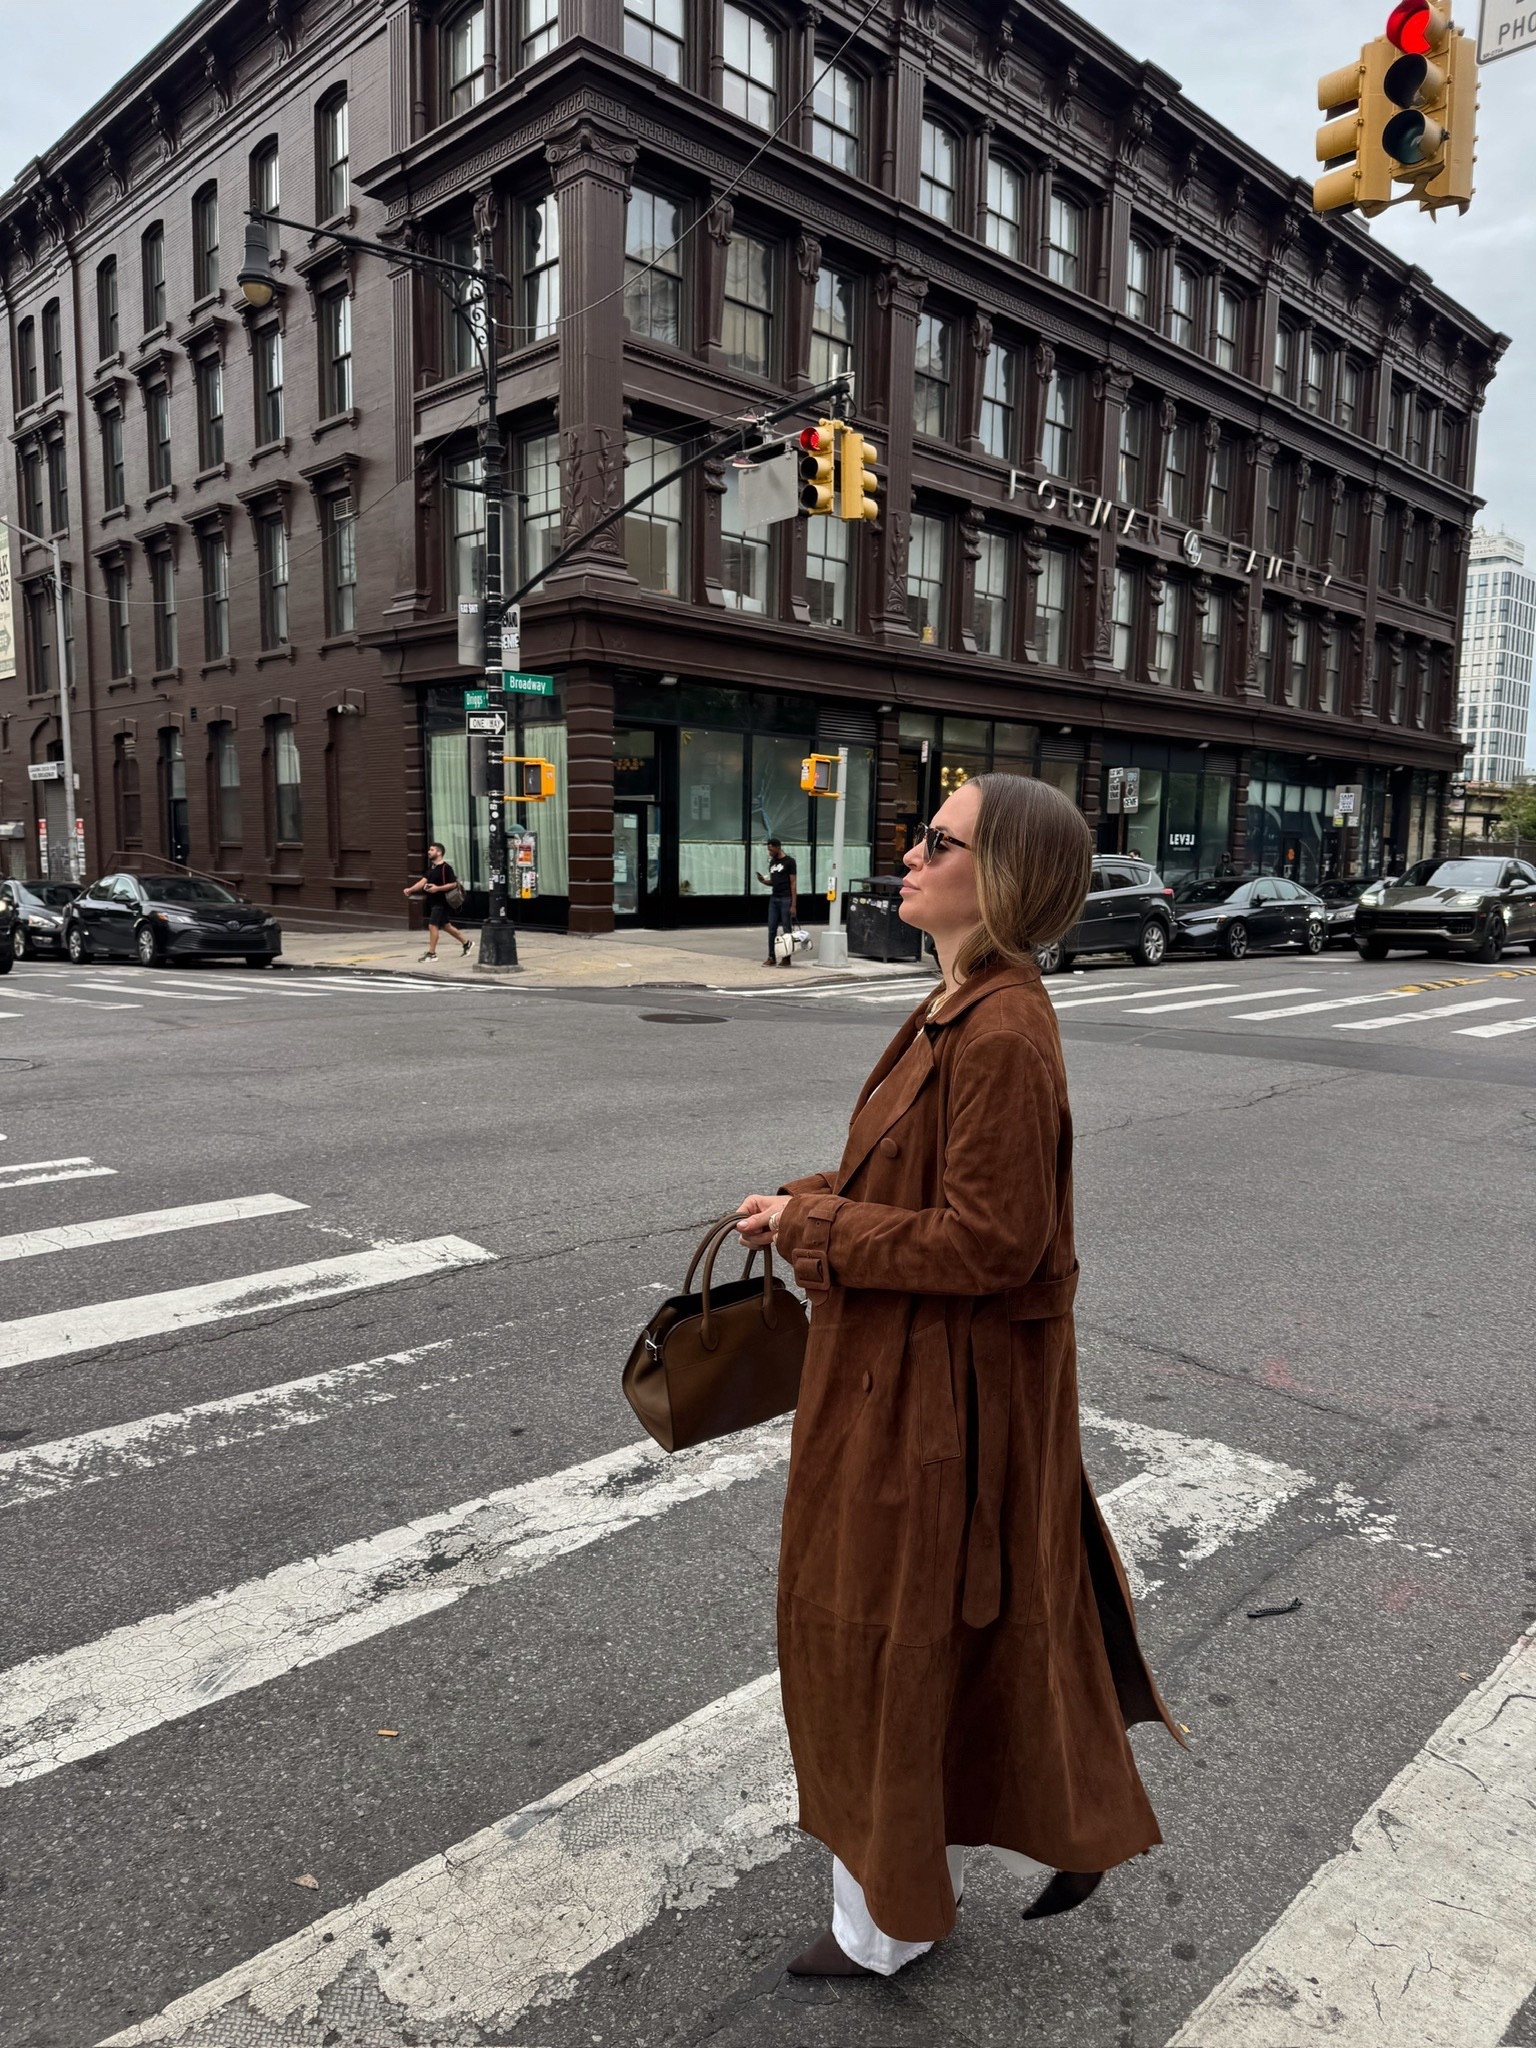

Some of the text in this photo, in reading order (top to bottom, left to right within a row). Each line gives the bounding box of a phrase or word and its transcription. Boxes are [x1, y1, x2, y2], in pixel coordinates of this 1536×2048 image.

[1008, 468, 1163, 546] FORMAN
[509, 675, 546, 694] Broadway
[466, 692, 483, 708] Driggs
[472, 719, 501, 728] ONE WAY
[1169, 833, 1195, 846] LEVEL
